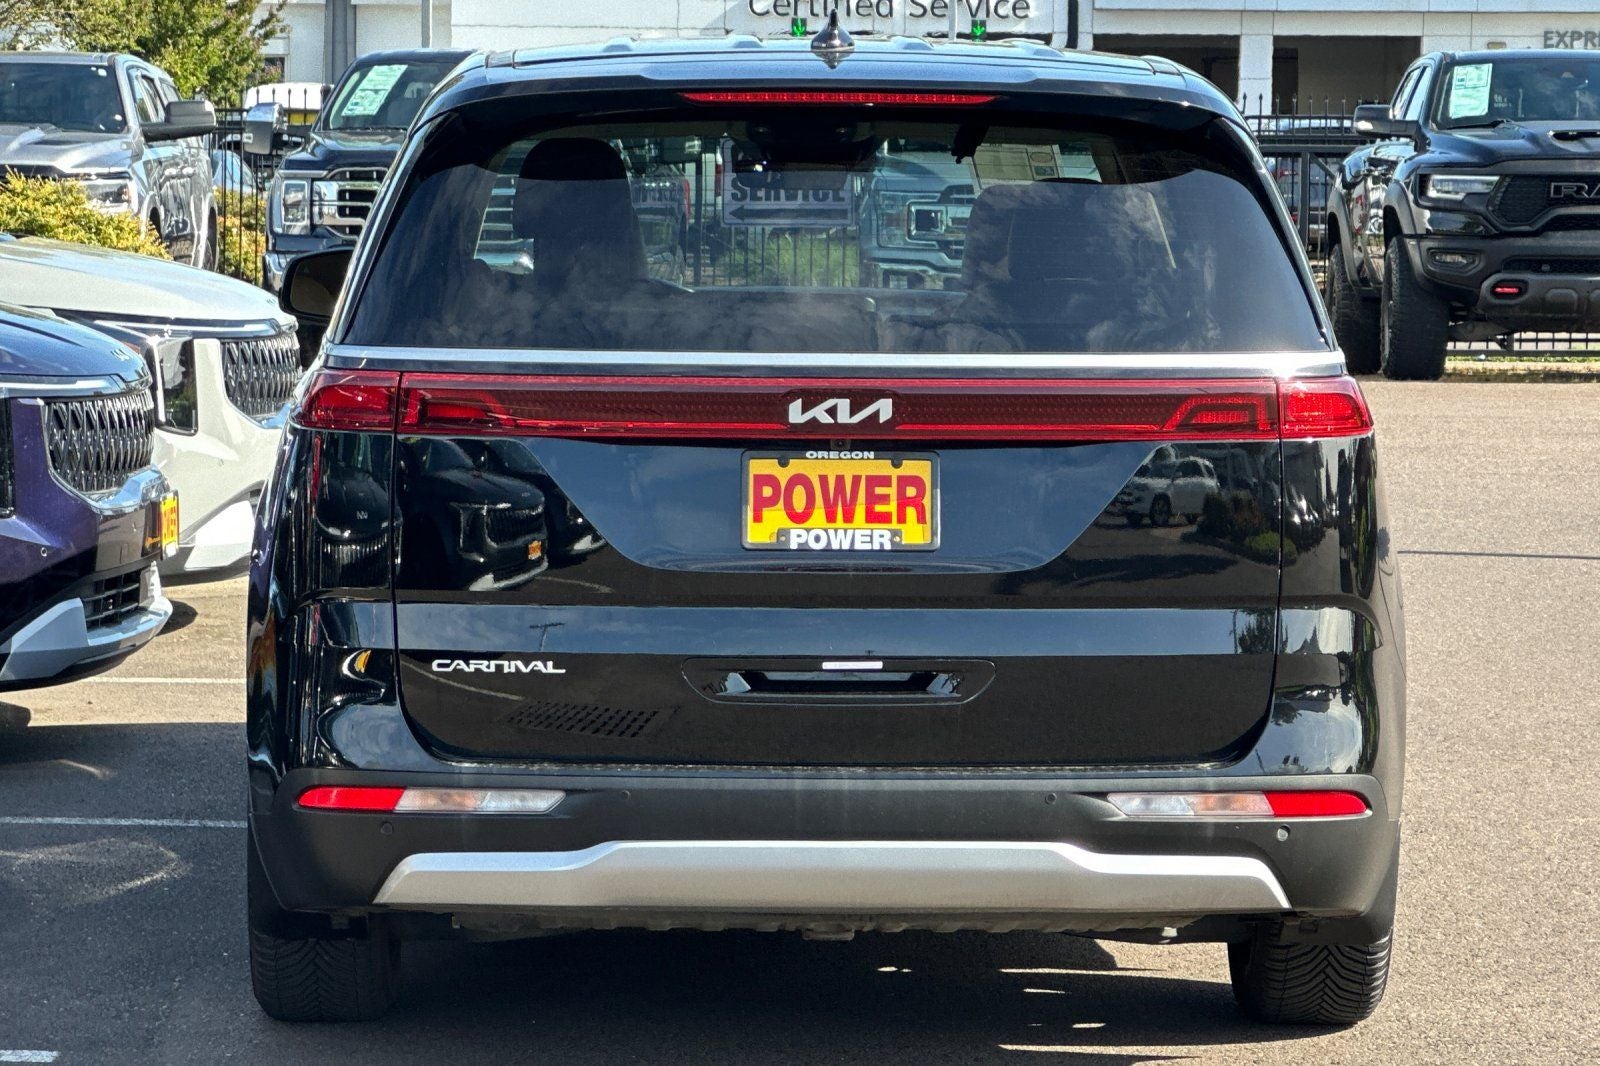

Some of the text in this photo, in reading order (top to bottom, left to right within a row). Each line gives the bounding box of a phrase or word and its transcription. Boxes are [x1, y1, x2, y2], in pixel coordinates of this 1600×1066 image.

[749, 0, 1030, 18] Certiied Sevice
[1543, 30, 1600, 49] EXPR
[788, 398, 893, 424] KIA
[805, 450, 875, 460] OREGON
[752, 473, 927, 525] POWER
[789, 528, 892, 550] POWER
[431, 659, 567, 674] CARNIVAL
